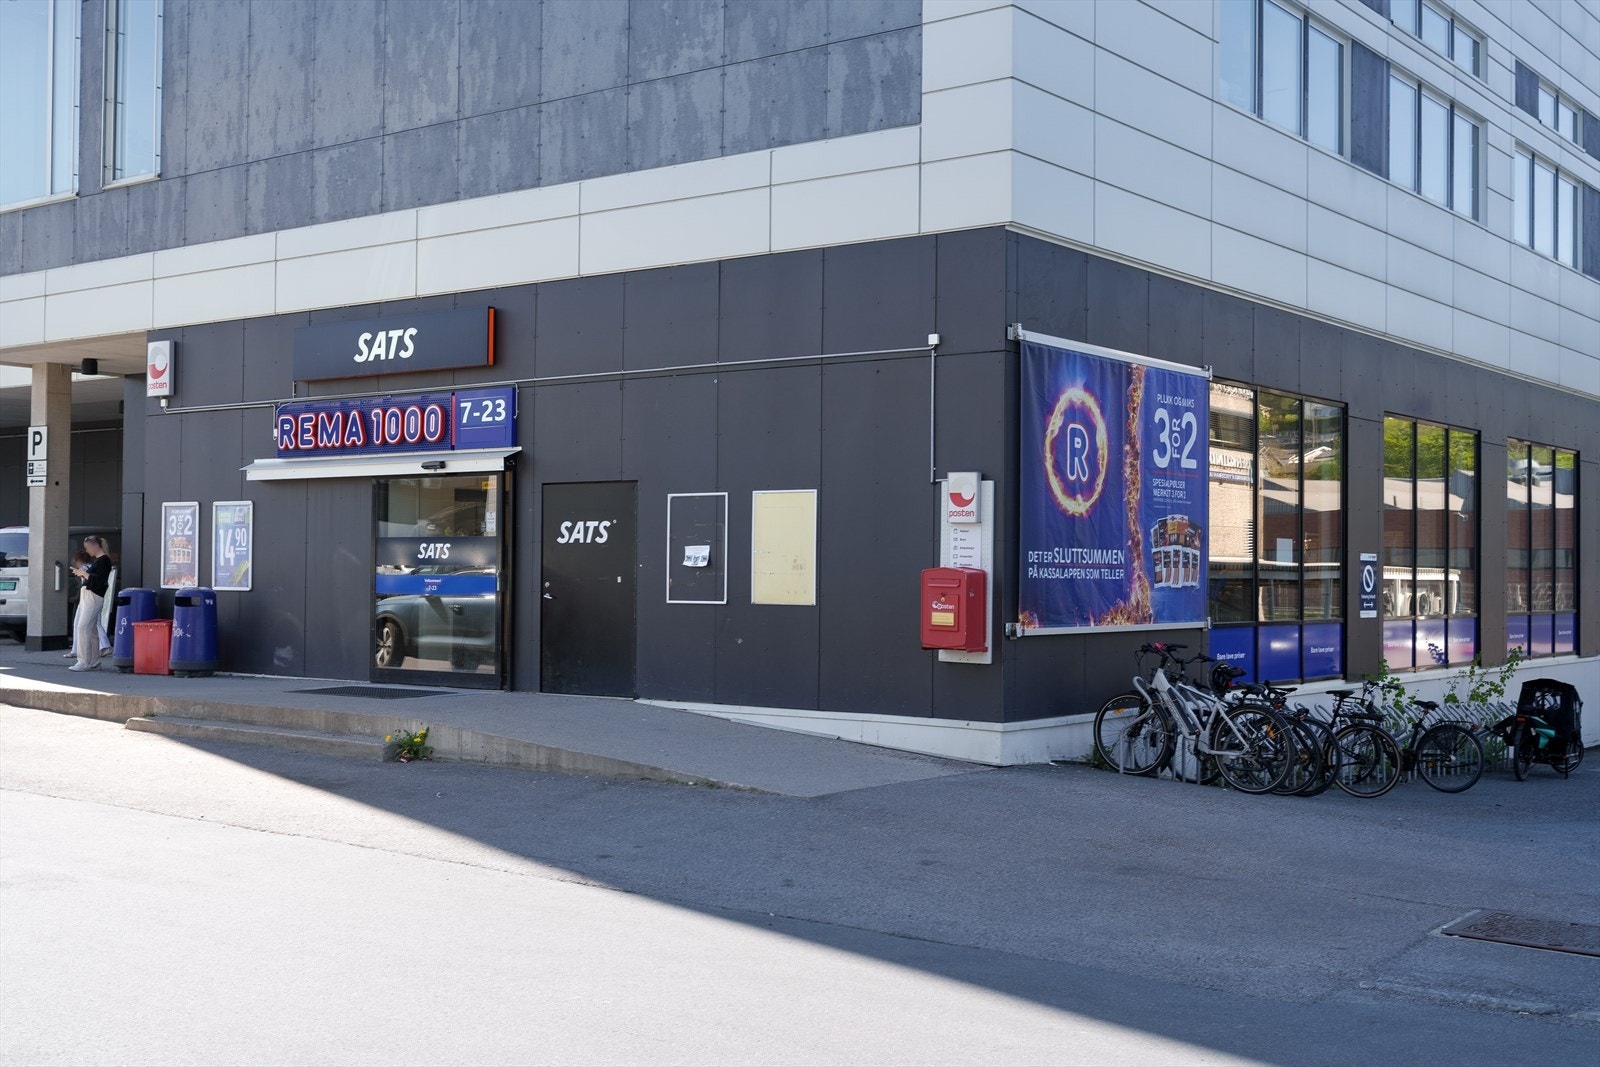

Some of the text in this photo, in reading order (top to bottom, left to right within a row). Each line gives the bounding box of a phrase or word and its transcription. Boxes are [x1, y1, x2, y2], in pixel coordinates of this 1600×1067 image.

[354, 327, 418, 363] SATS
[1157, 394, 1173, 404] PLUKK
[1174, 396, 1182, 406] OG
[460, 399, 506, 424] 7-23
[278, 404, 445, 450] REMA 1000
[32, 431, 42, 456] P
[1153, 408, 1197, 469] 3 FOR 2
[1067, 423, 1089, 482] R
[1152, 478, 1186, 489] SPESIALPØLSER
[1175, 490, 1183, 498] FOR
[949, 509, 975, 518] posten
[169, 515, 176, 536] 3
[184, 515, 192, 535] 2
[556, 520, 611, 544] SATS
[219, 528, 247, 566] 14 90
[417, 543, 451, 559] SATS
[1028, 548, 1124, 564] DET ER SLUTTSUMMEN
[1028, 565, 1124, 579] PÅ KASSALAPPEN SOM TELLER
[1234, 652, 1245, 660] priser
